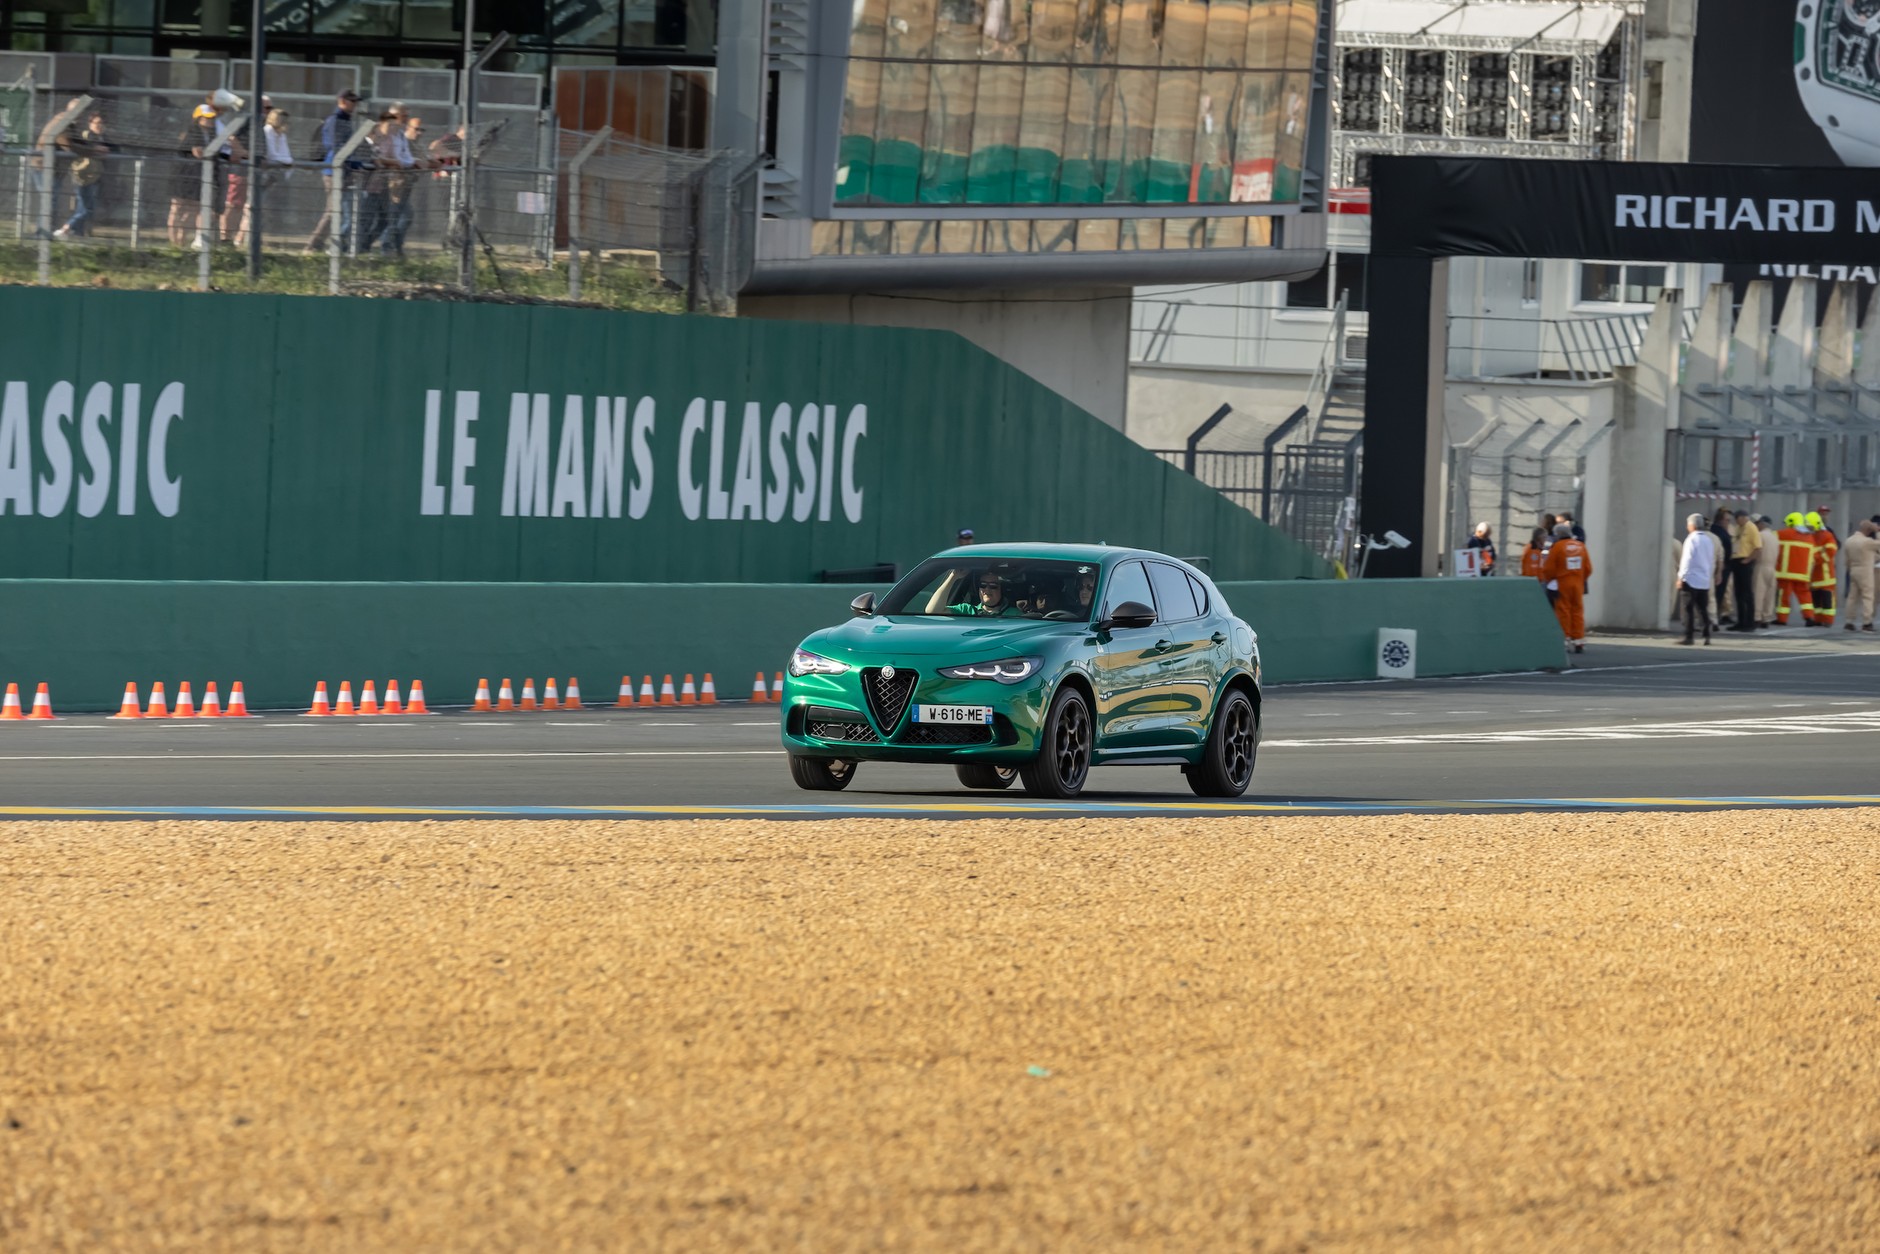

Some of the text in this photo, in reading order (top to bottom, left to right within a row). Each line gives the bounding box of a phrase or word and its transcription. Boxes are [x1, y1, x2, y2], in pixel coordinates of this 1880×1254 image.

[1615, 194, 1835, 232] RICHARD
[0, 380, 185, 518] ASSIC
[420, 389, 867, 523] LE MANS CLASSIC
[929, 708, 983, 721] W-616-ME
